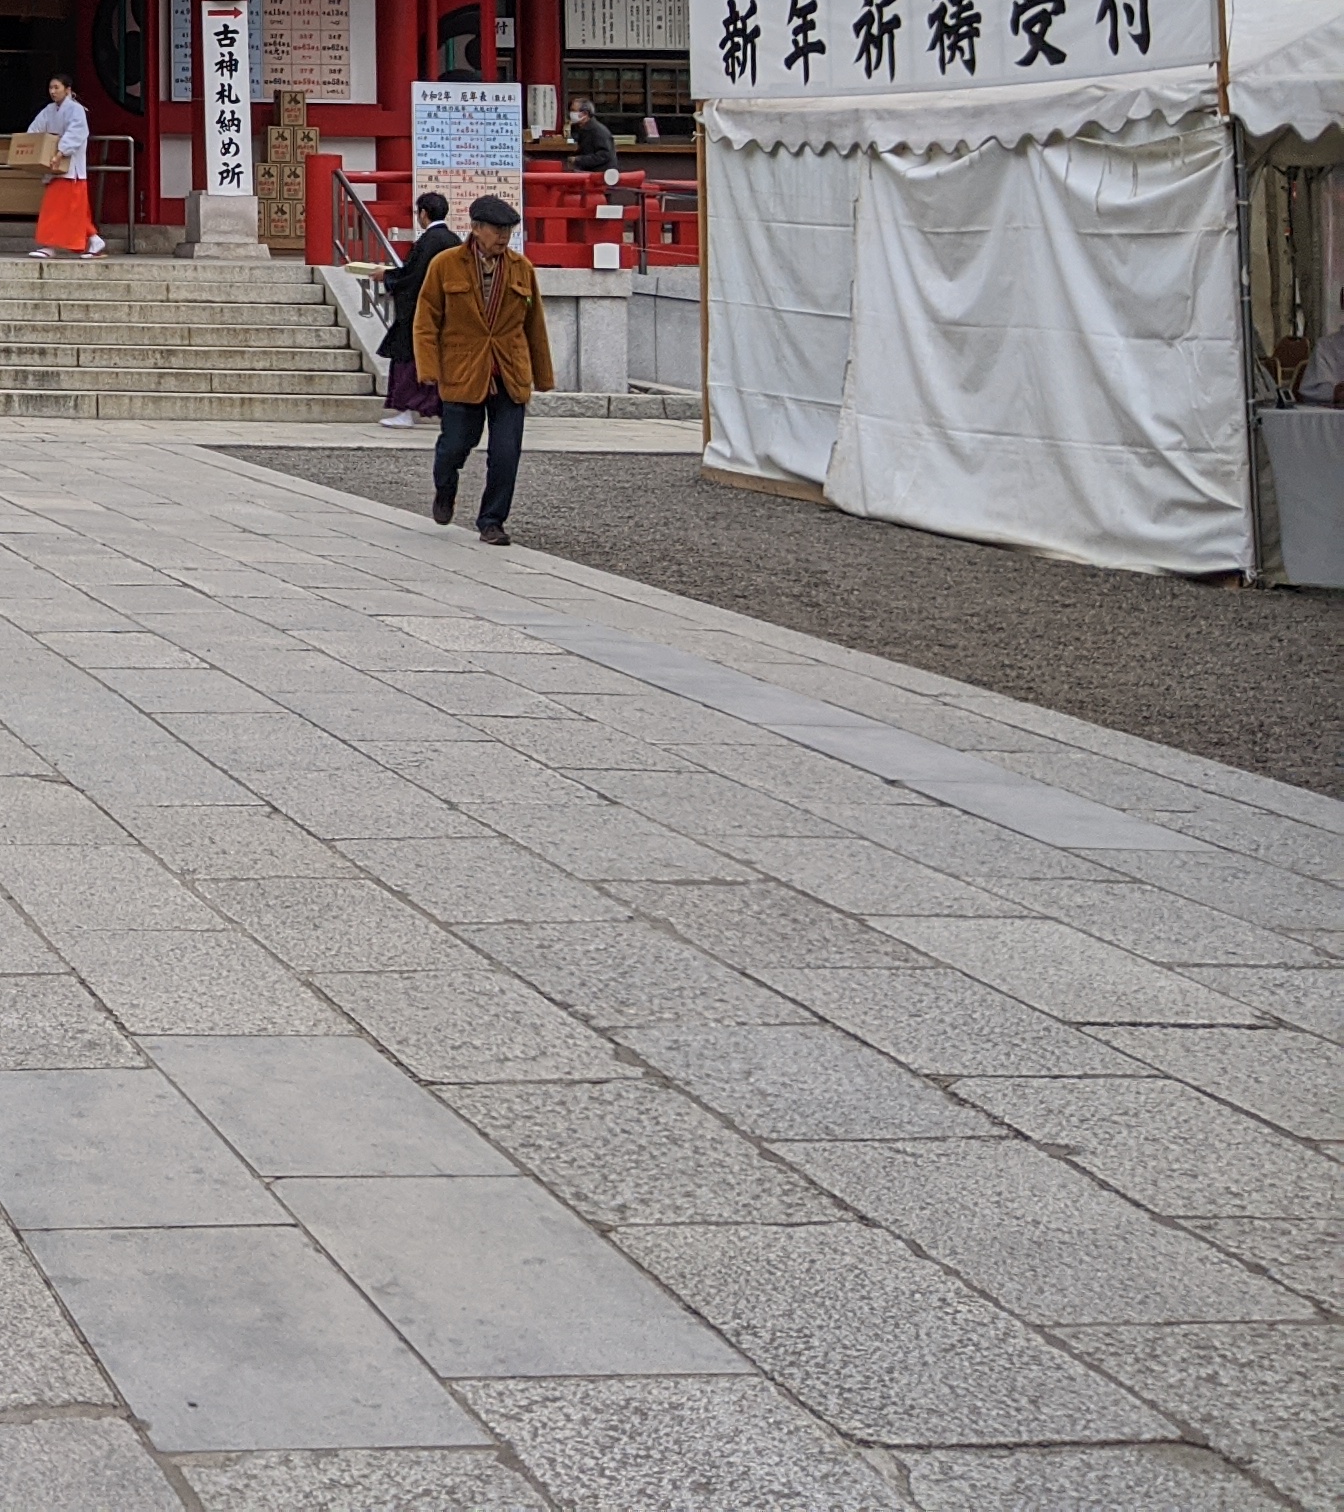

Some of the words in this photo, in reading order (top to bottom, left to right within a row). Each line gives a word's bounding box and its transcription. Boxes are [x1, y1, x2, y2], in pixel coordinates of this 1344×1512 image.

[213, 23, 244, 189] 古神札納め所
